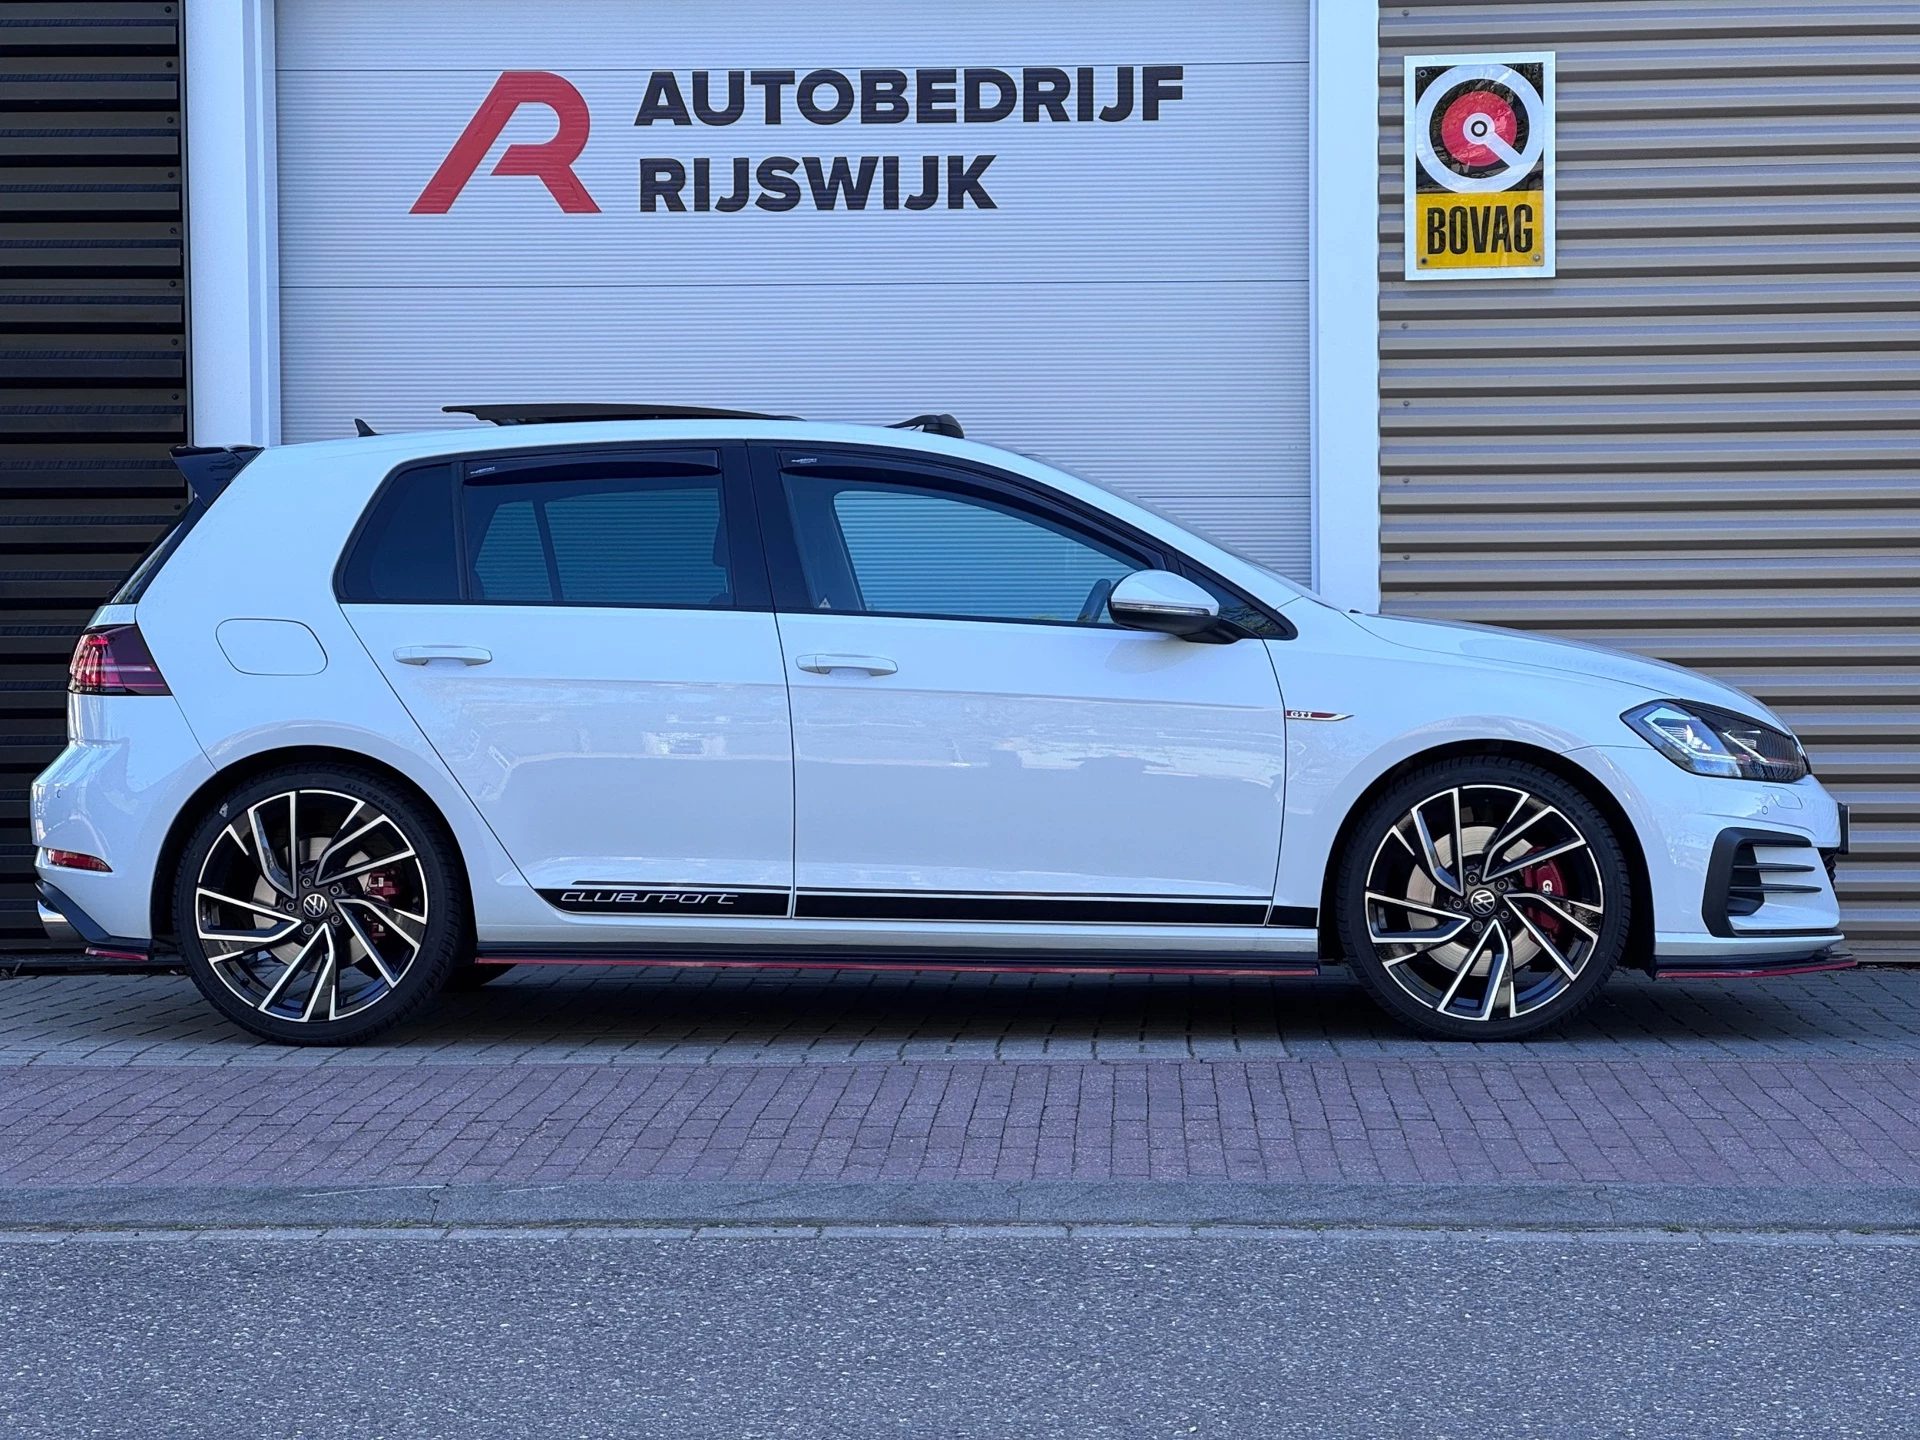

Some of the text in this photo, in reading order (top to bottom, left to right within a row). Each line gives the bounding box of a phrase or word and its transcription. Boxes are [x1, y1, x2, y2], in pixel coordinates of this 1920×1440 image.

[634, 65, 1185, 127] AUTOBEDRIJF
[640, 154, 999, 213] RIJSWIJK
[1427, 204, 1533, 255] BOVAG
[1290, 710, 1313, 718] GTI
[344, 783, 363, 794] ALL
[365, 791, 404, 820] SEASON
